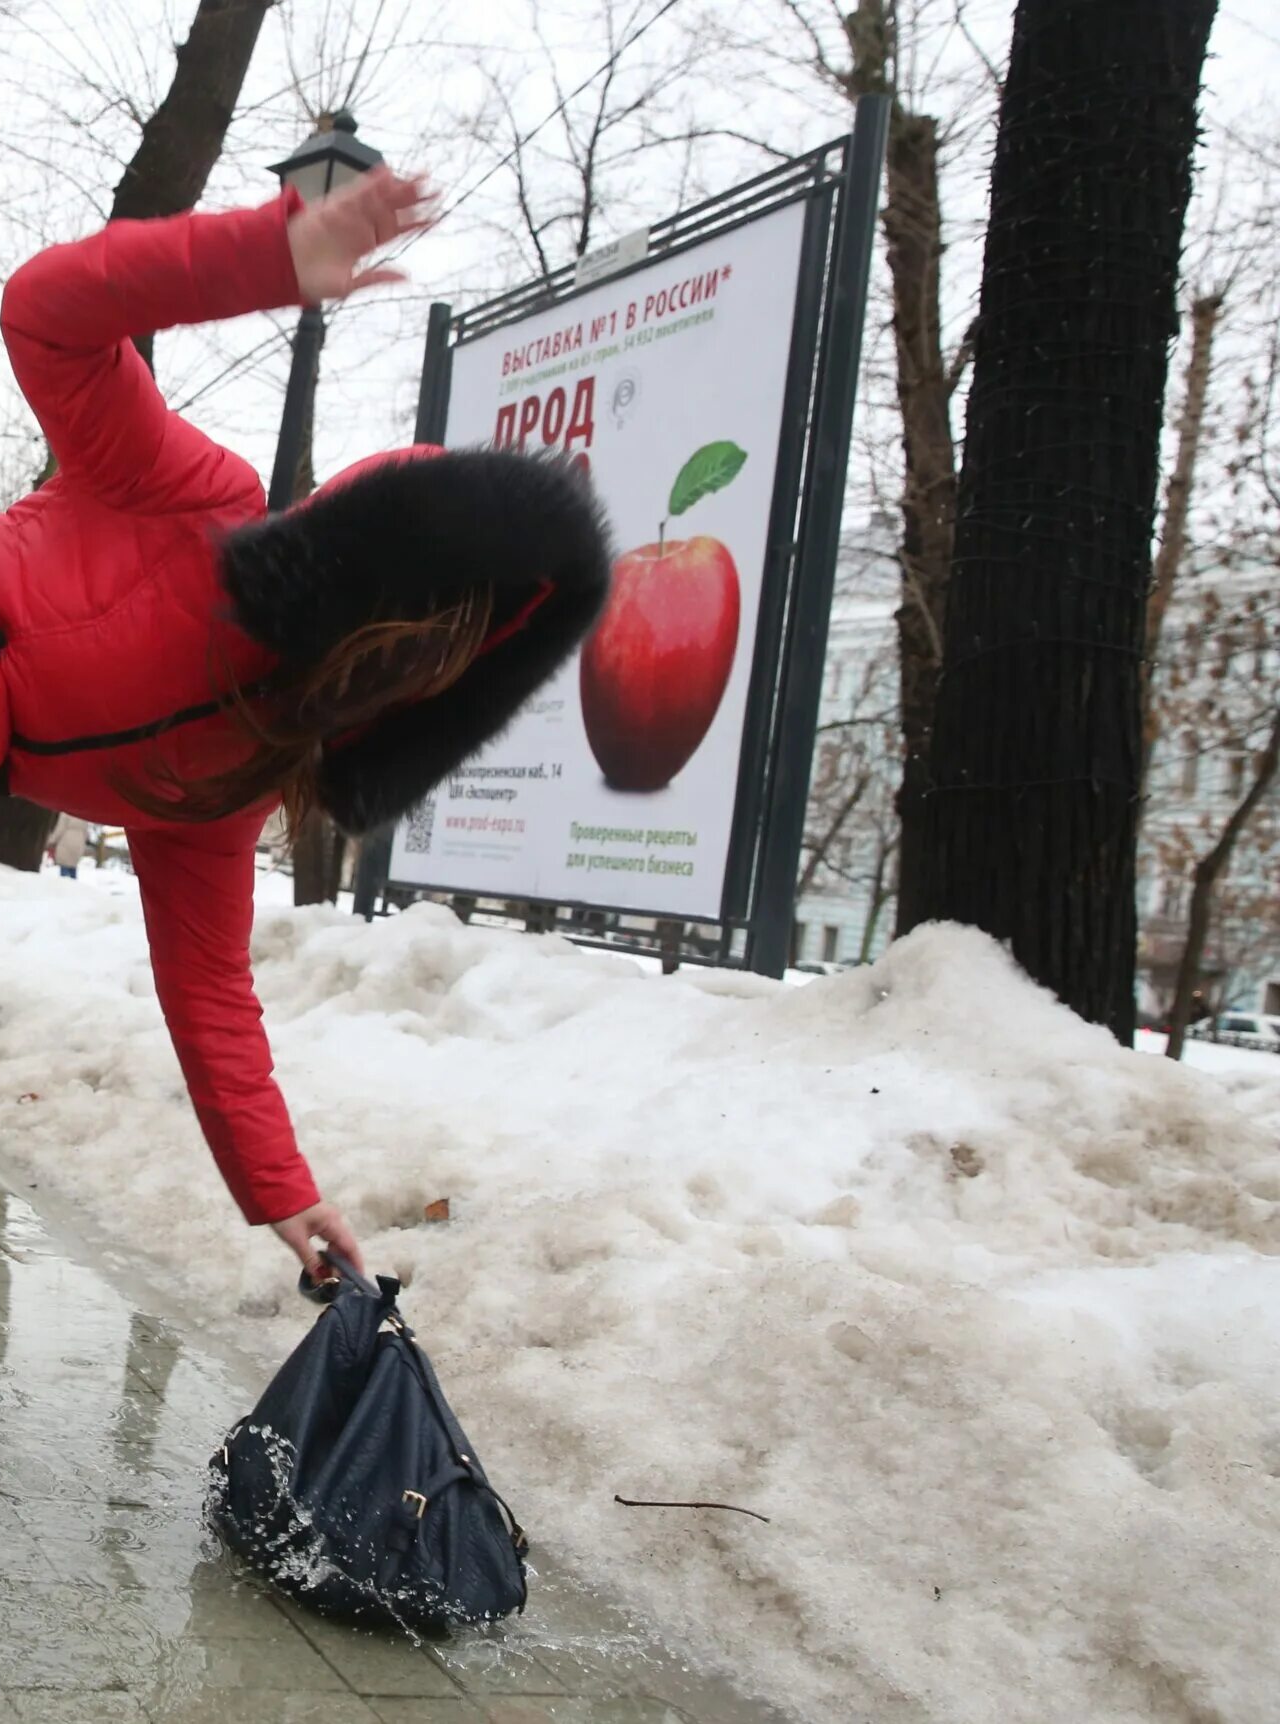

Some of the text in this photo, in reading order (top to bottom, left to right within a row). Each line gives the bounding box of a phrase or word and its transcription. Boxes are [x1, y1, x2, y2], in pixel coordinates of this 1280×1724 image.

[502, 320, 583, 376] ВЫСТАВКА
[626, 302, 637, 330] В
[493, 375, 596, 455] ПРОД
[552, 763, 562, 778] 14
[569, 820, 698, 848] Проверенные рецепты
[566, 853, 694, 877] для успешного бизнеса
